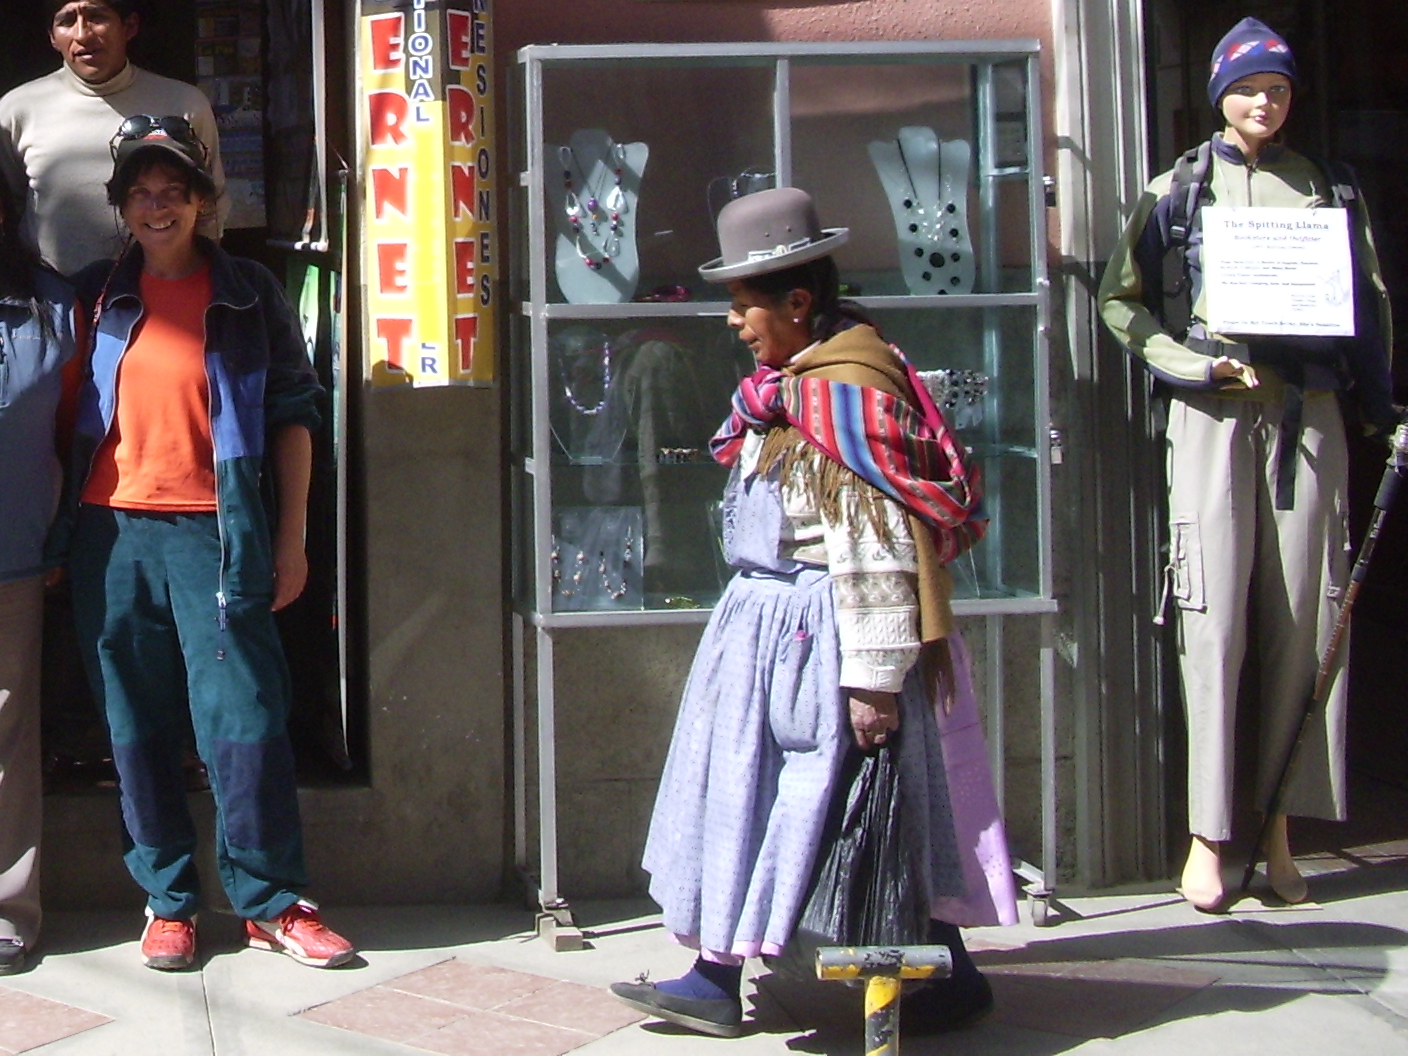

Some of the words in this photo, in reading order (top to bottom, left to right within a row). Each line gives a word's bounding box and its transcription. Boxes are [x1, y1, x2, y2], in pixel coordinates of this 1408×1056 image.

[1224, 220, 1244, 228] The
[1248, 220, 1293, 231] Spitting
[1296, 220, 1329, 230] Llama
